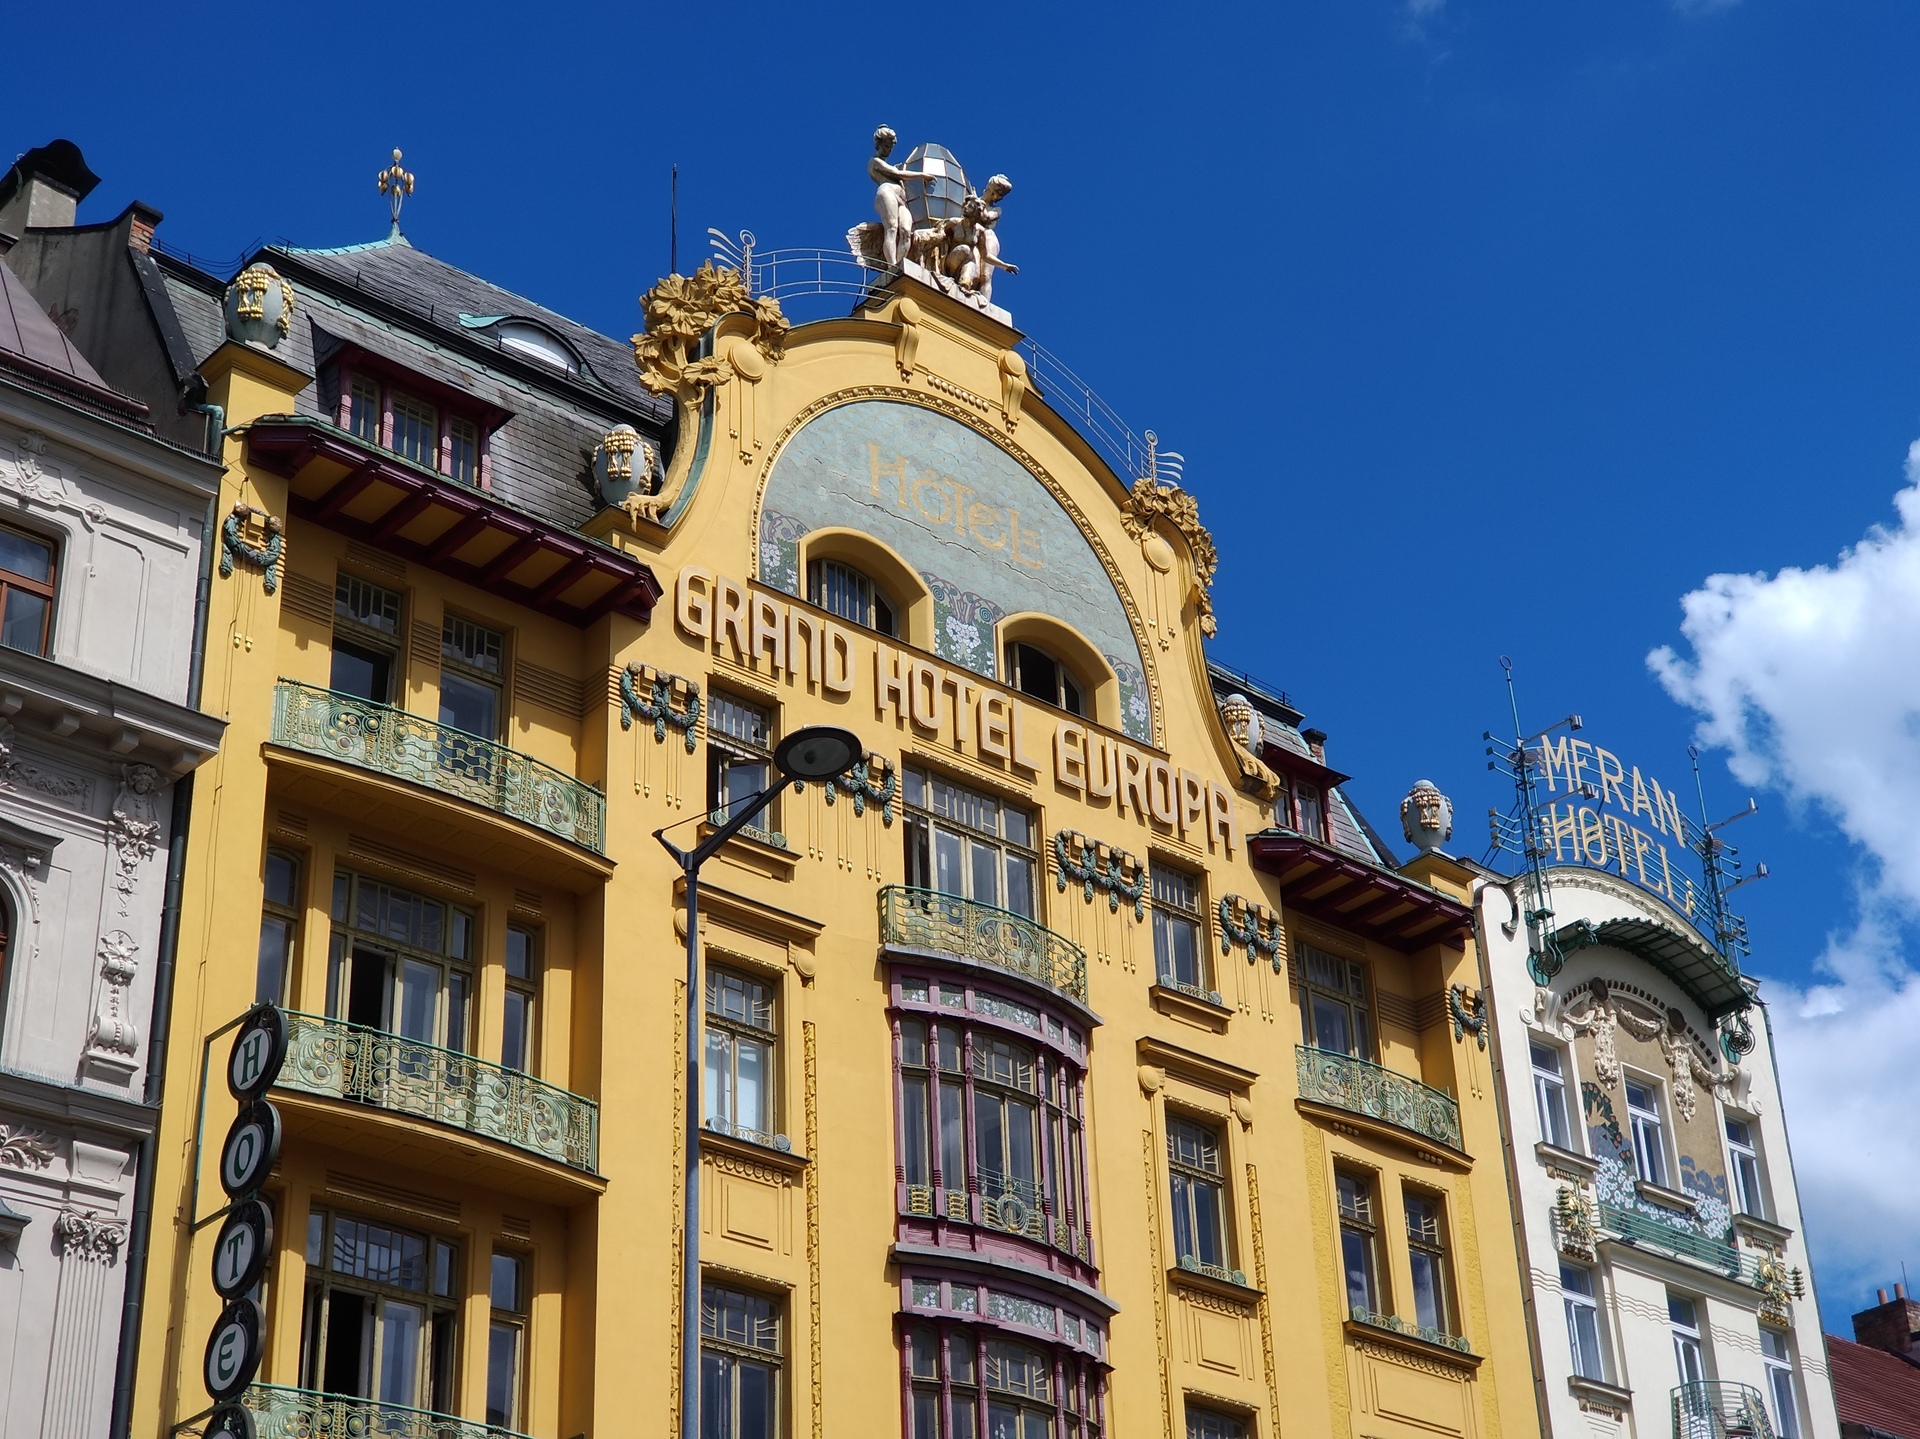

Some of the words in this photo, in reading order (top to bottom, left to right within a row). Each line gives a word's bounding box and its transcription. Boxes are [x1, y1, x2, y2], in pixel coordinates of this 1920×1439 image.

[675, 565, 857, 694] GRAND
[876, 641, 1042, 774] HOTEL
[1054, 722, 1239, 852] EUROPA
[1541, 734, 1686, 849] MERAN
[1550, 802, 1693, 918] HOTEL
[217, 1032, 261, 1382] HOTE
